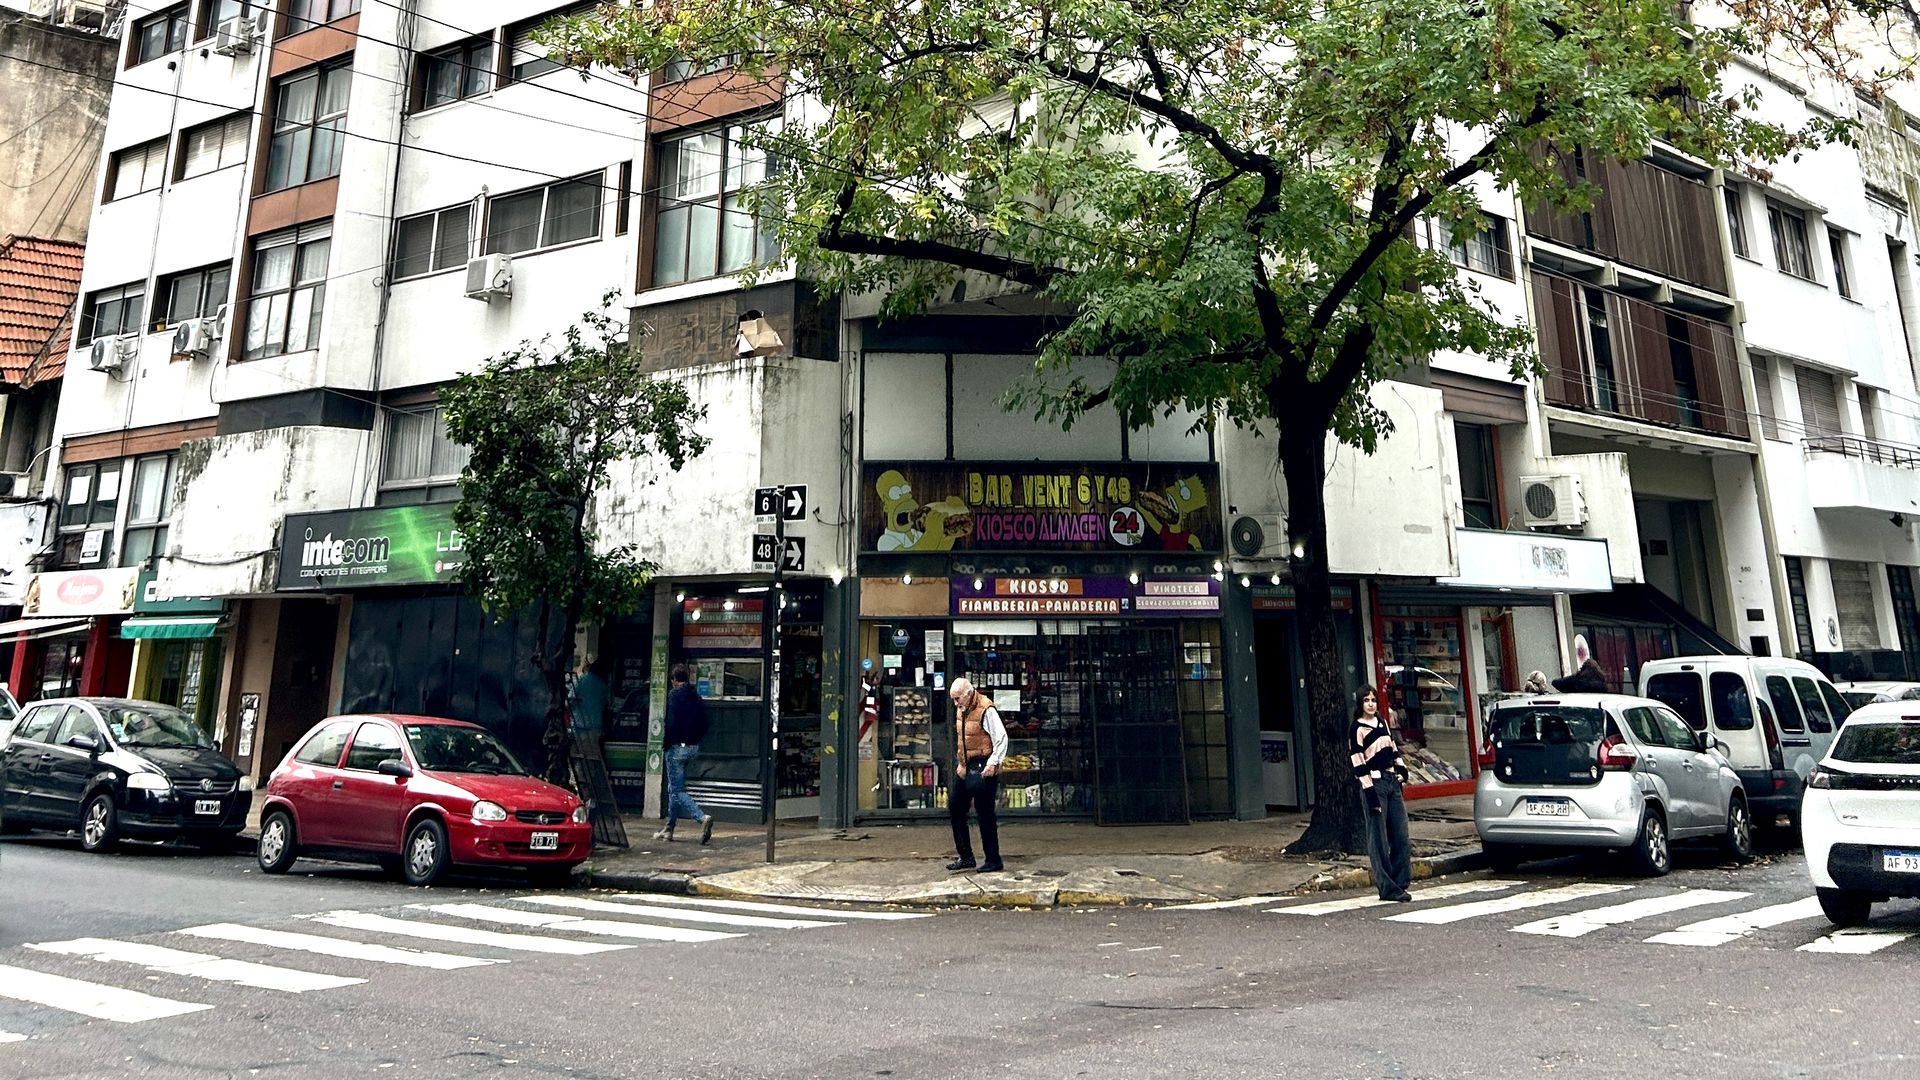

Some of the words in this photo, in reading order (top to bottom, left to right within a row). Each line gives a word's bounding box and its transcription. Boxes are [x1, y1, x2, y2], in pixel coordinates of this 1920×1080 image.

[1077, 475, 1091, 504] 6
[762, 496, 770, 512] 6
[976, 513, 1036, 542] KIOSCO
[1112, 511, 1140, 534] 24
[1126, 533, 1142, 545] hs
[757, 543, 771, 559] 48
[1153, 584, 1201, 593] VINOTECA
[960, 598, 1118, 612] FIAMBRERIA-PANADERIA
[1887, 857, 1901, 869] AF
